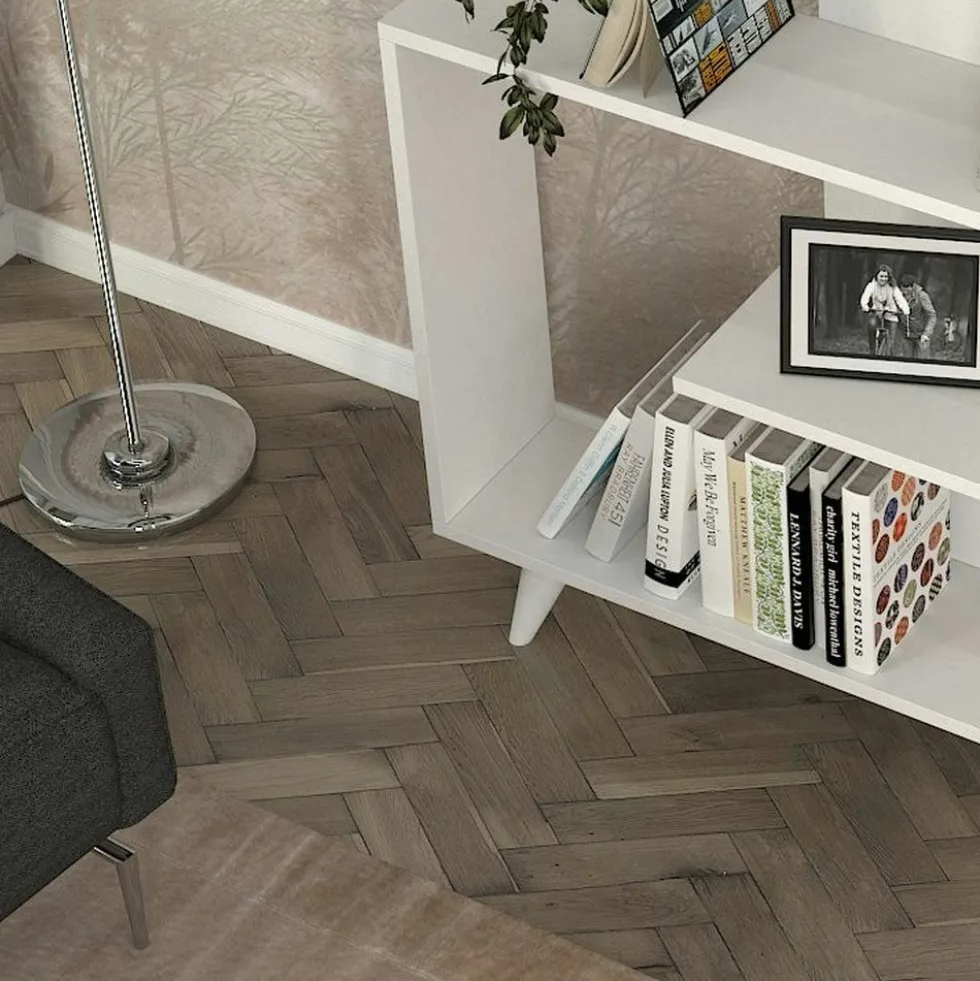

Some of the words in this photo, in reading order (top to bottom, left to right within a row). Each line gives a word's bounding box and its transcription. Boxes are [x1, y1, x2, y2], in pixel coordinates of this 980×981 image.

[621, 442, 634, 464] RAY
[664, 426, 675, 450] ELLEN
[620, 453, 646, 501] FAHRENHEIT
[663, 450, 673, 468] AND
[700, 448, 715, 472] May
[601, 467, 626, 519] BRADBURY
[660, 468, 672, 489] JULIA
[704, 474, 717, 490] We
[704, 490, 718, 503] Be
[608, 502, 625, 528] 451
[659, 489, 670, 521] LUPTON
[740, 496, 748, 548] MATTHEW
[825, 505, 836, 541] charity
[703, 504, 719, 547] Forgiven
[790, 513, 802, 573] LENNARD
[654, 525, 669, 579] DESIGN
[826, 541, 838, 563] girl
[851, 511, 861, 583] TEXTILE
[793, 574, 802, 587] J.
[828, 569, 839, 608] michael
[794, 590, 804, 629] DAVIS
[853, 586, 863, 657] DESIGNS
[829, 608, 841, 657] lowenthal
